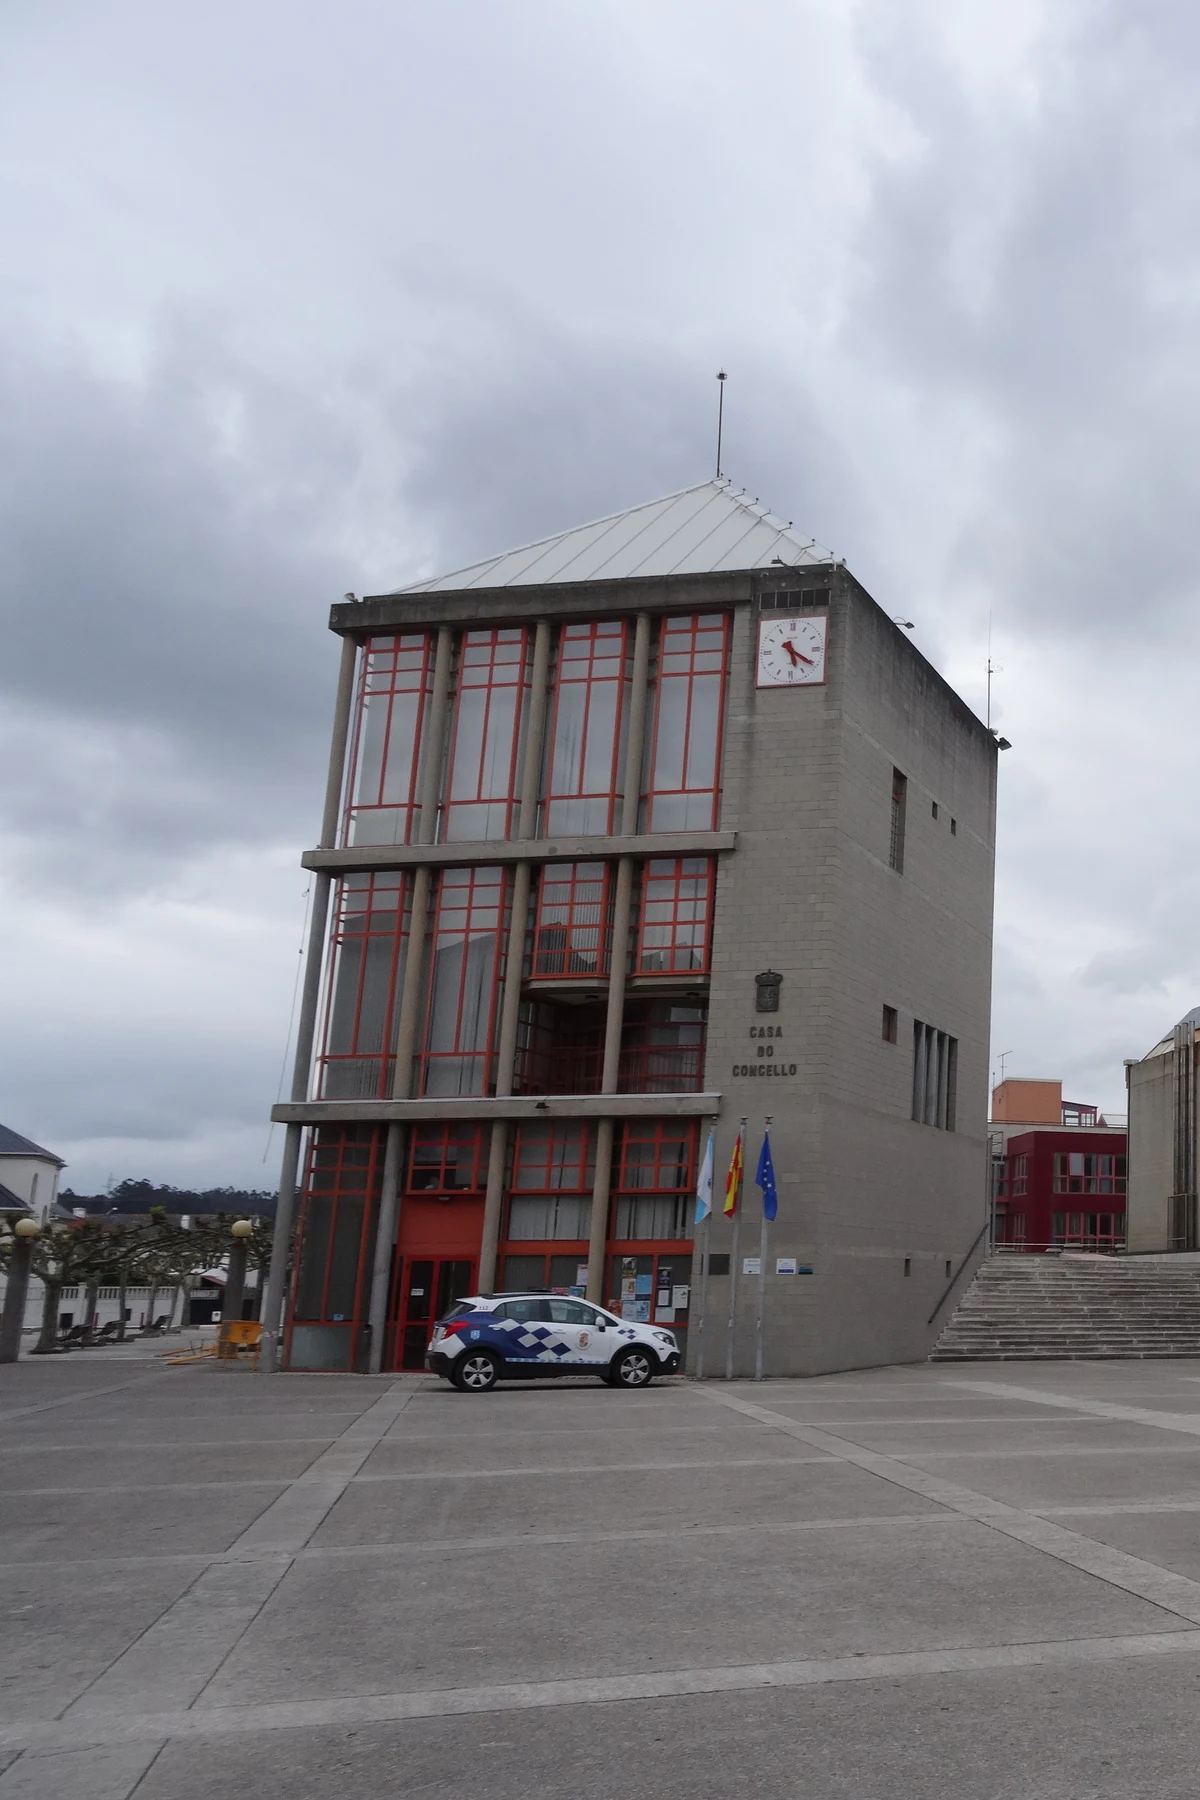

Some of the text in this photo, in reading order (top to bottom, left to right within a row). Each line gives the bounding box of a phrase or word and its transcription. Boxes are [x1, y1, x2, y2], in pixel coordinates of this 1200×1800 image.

[749, 1026, 783, 1039] CASA
[757, 1045, 774, 1058] DO
[732, 1064, 797, 1077] CONCELLO
